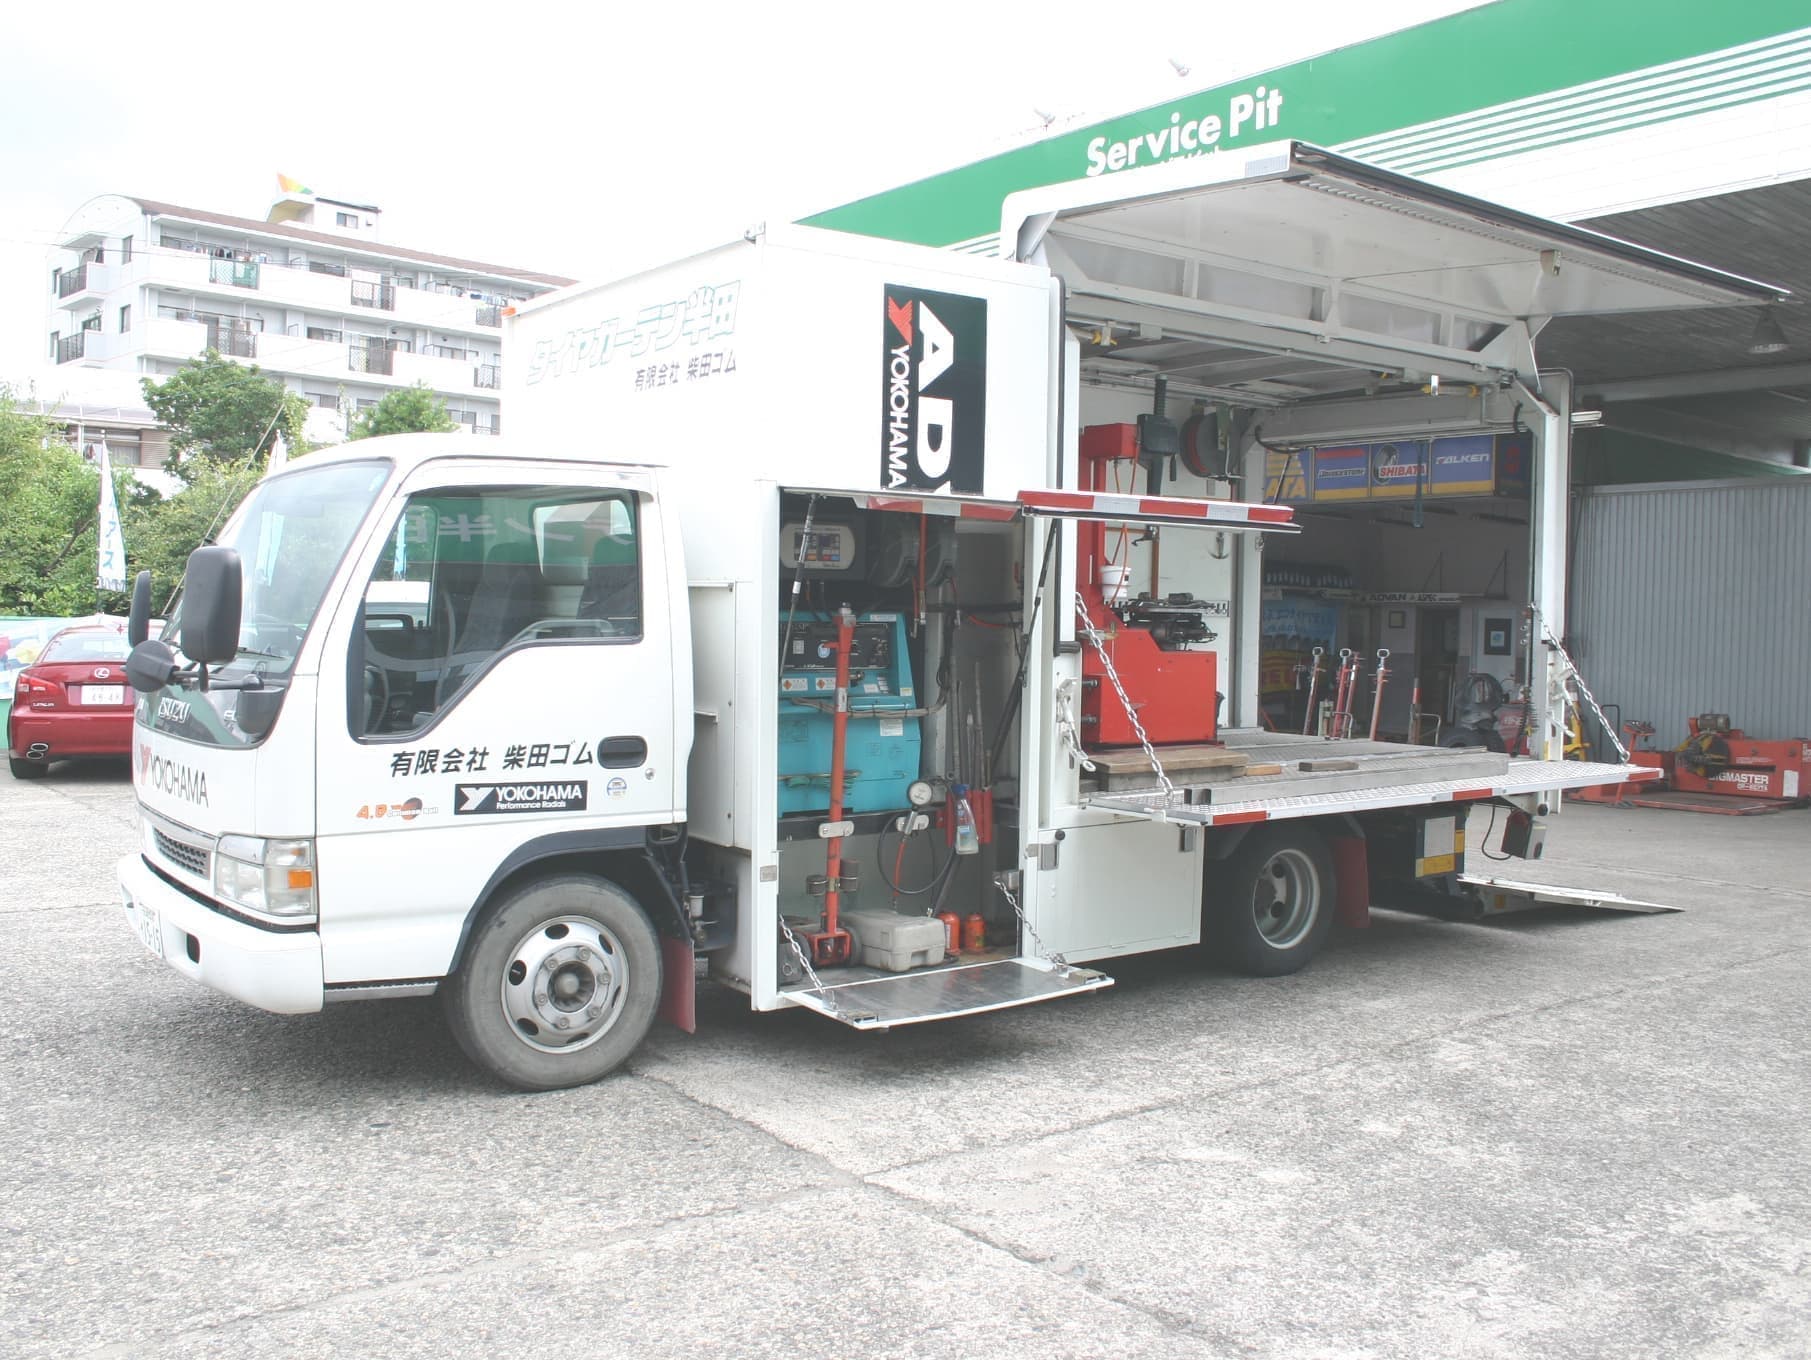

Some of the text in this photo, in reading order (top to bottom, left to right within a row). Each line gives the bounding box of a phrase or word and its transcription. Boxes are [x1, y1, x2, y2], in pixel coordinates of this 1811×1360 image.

[1086, 112, 1222, 177] Service
[1229, 86, 1283, 138] Pit
[635, 349, 737, 391] 有限会社 柴田ゴム
[888, 345, 910, 489] YOKOHAMA
[916, 300, 954, 494] AD
[1435, 453, 1490, 465] FALKEN
[390, 739, 593, 778] 有限会社 柴田ゴム
[149, 753, 209, 808] YOKOHAMA
[495, 784, 582, 801] YOKOHAMA
[496, 800, 566, 810] Performance Radials
